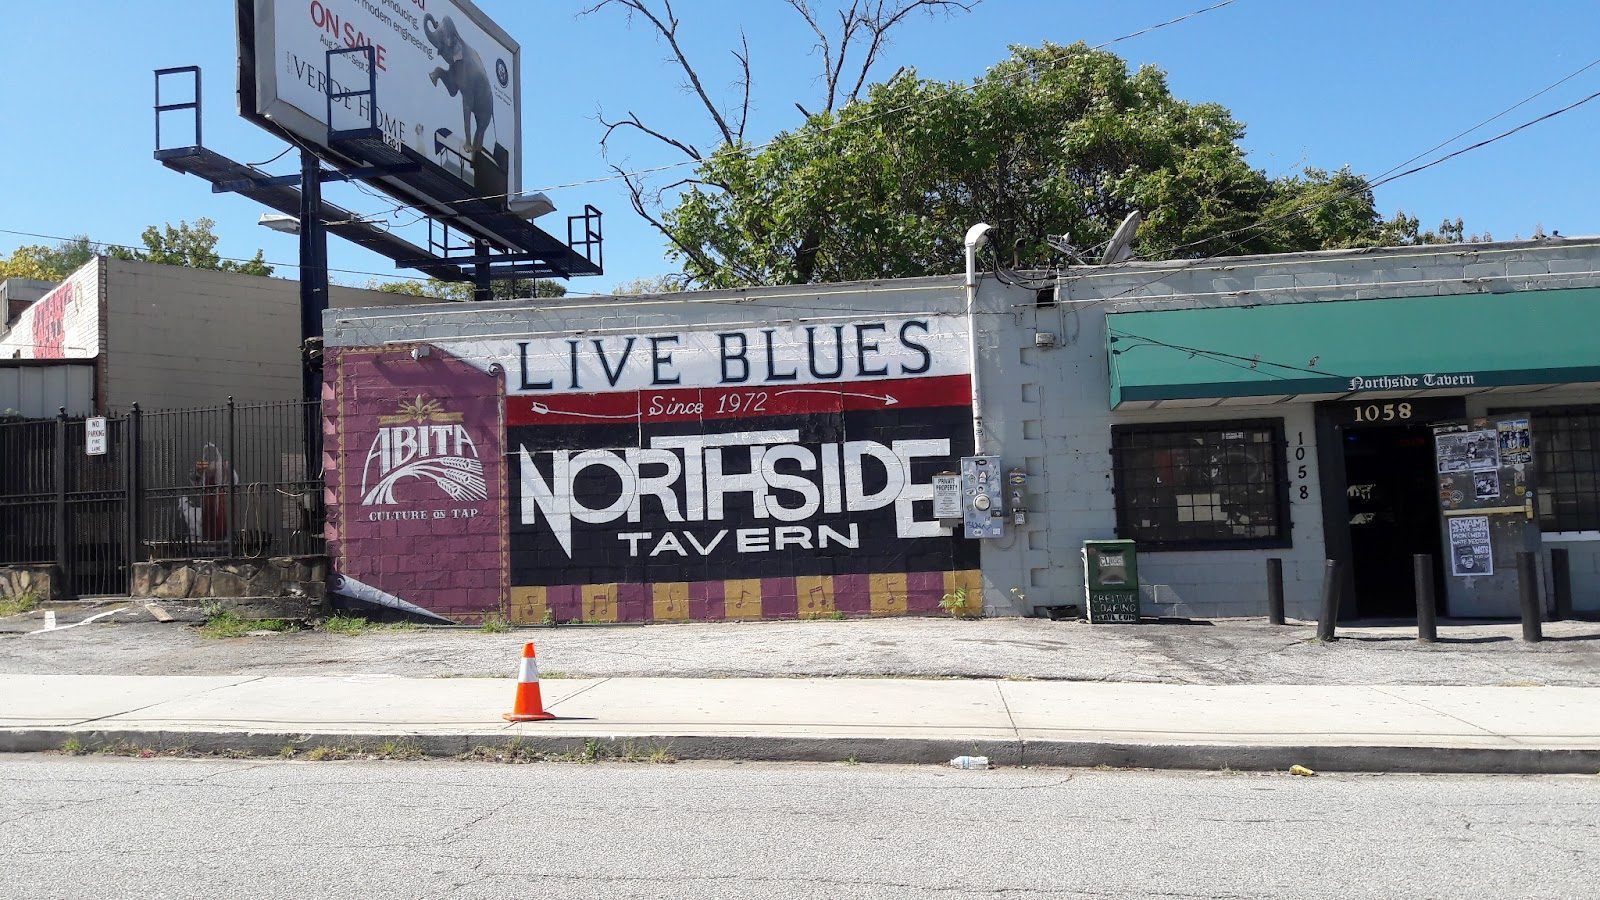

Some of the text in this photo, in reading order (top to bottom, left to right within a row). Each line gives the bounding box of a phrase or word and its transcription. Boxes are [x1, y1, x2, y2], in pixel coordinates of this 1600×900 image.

[311, 0, 339, 39] ON
[319, 34, 333, 50] Aug
[293, 55, 351, 110] VERDE
[359, 96, 405, 142] HOME
[517, 320, 932, 391] LIVE BLUES
[1347, 373, 1475, 391] Northside Tavern
[649, 392, 768, 417] Since 1972
[1354, 402, 1412, 422] 1058
[360, 424, 479, 498] ABITA
[1295, 431, 1309, 500] 1058
[520, 430, 954, 559] NORTHSIDE
[368, 508, 479, 522] CULTURE ON TAP
[617, 522, 860, 557] TAVERN
[1092, 594, 1136, 604] CREATIVE
